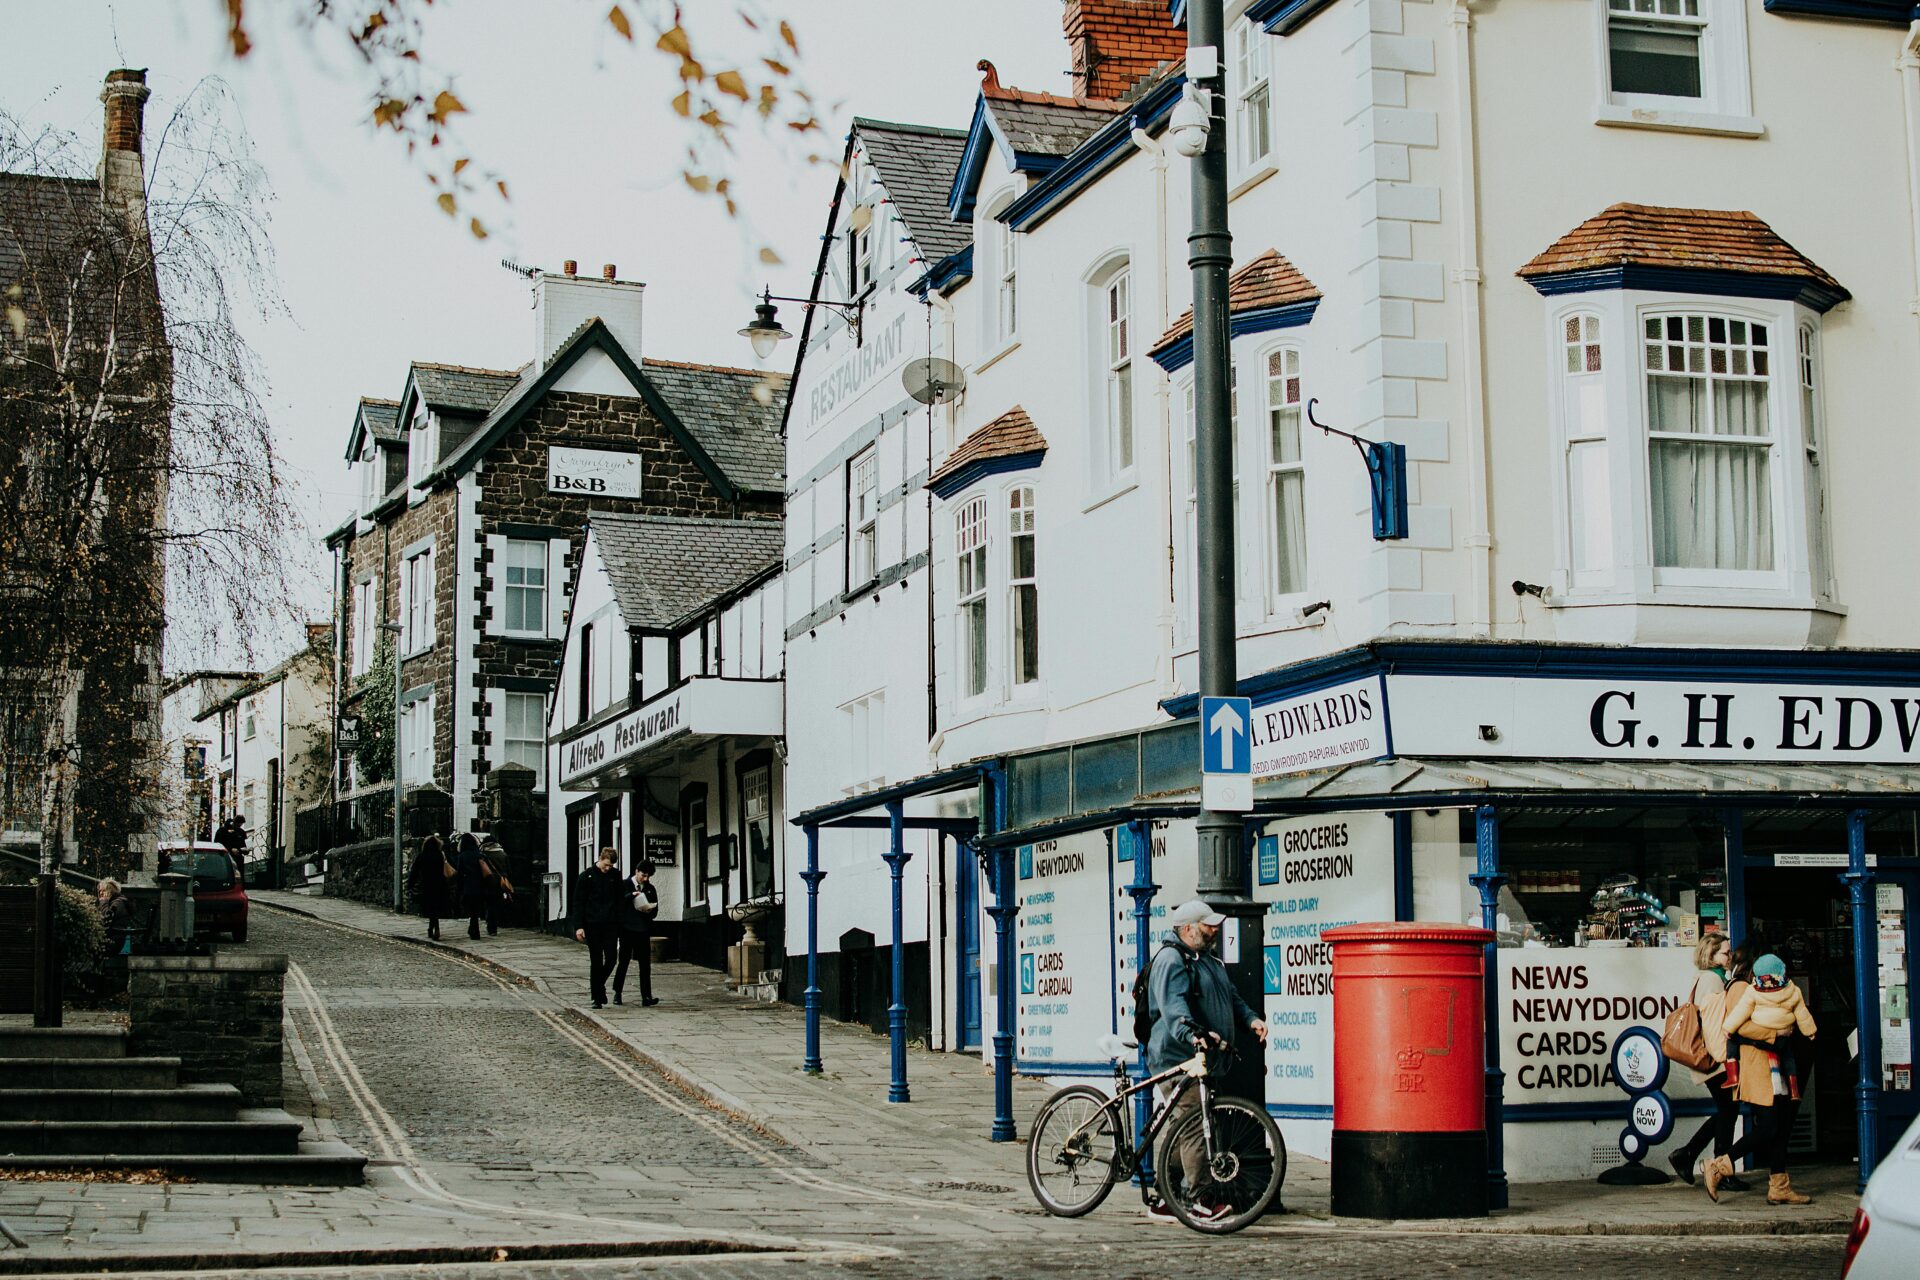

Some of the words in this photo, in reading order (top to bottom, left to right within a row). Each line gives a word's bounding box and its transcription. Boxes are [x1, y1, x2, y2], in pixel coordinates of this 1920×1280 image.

[811, 312, 905, 425] RESTAURANT
[553, 475, 606, 492] B&B
[339, 730, 359, 741] B&B
[569, 733, 604, 773] Alfredo
[614, 696, 681, 753] Restaurant
[1309, 745, 1339, 763] PAPURAU
[1340, 738, 1370, 755] NEWYDD
[650, 838, 672, 846] Pizza
[1284, 823, 1348, 854] GROCERIES
[1036, 852, 1084, 878] NEWYDDION
[1285, 854, 1353, 884] GROSERION
[1027, 891, 1055, 905] NEWSPAPERS
[1271, 900, 1296, 915] CHILLED
[1299, 898, 1319, 913] DAIRY
[1027, 913, 1052, 926] MAGAZINES
[1027, 935, 1041, 947] LOCAL
[1042, 933, 1055, 945] MAPS
[1271, 923, 1317, 940] CONVENIENCE
[1228, 936, 1235, 946] 7
[1038, 952, 1063, 972] CARDS
[1286, 943, 1334, 967] CONFEC
[1512, 965, 1589, 990] NEWS
[1038, 976, 1072, 997] CARDIAU
[1028, 1004, 1051, 1016] GREETINGS
[1053, 1003, 1068, 1015] CARDS
[1512, 996, 1678, 1022] NEWYDDION
[1273, 1012, 1317, 1025] CHOCOLATES
[1028, 1025, 1037, 1037] GIFT
[1039, 1025, 1052, 1037] WRAP
[1028, 1046, 1054, 1057] STATIONERY
[1273, 1038, 1300, 1051] SNACKS
[1517, 1031, 1607, 1057] CARDS
[1274, 1064, 1283, 1078] ICE
[1286, 1064, 1314, 1078] CREAMS
[1518, 1063, 1620, 1089] CARDIA
[1636, 1107, 1657, 1117] PLAY
[1636, 1117, 1656, 1126] NOW
